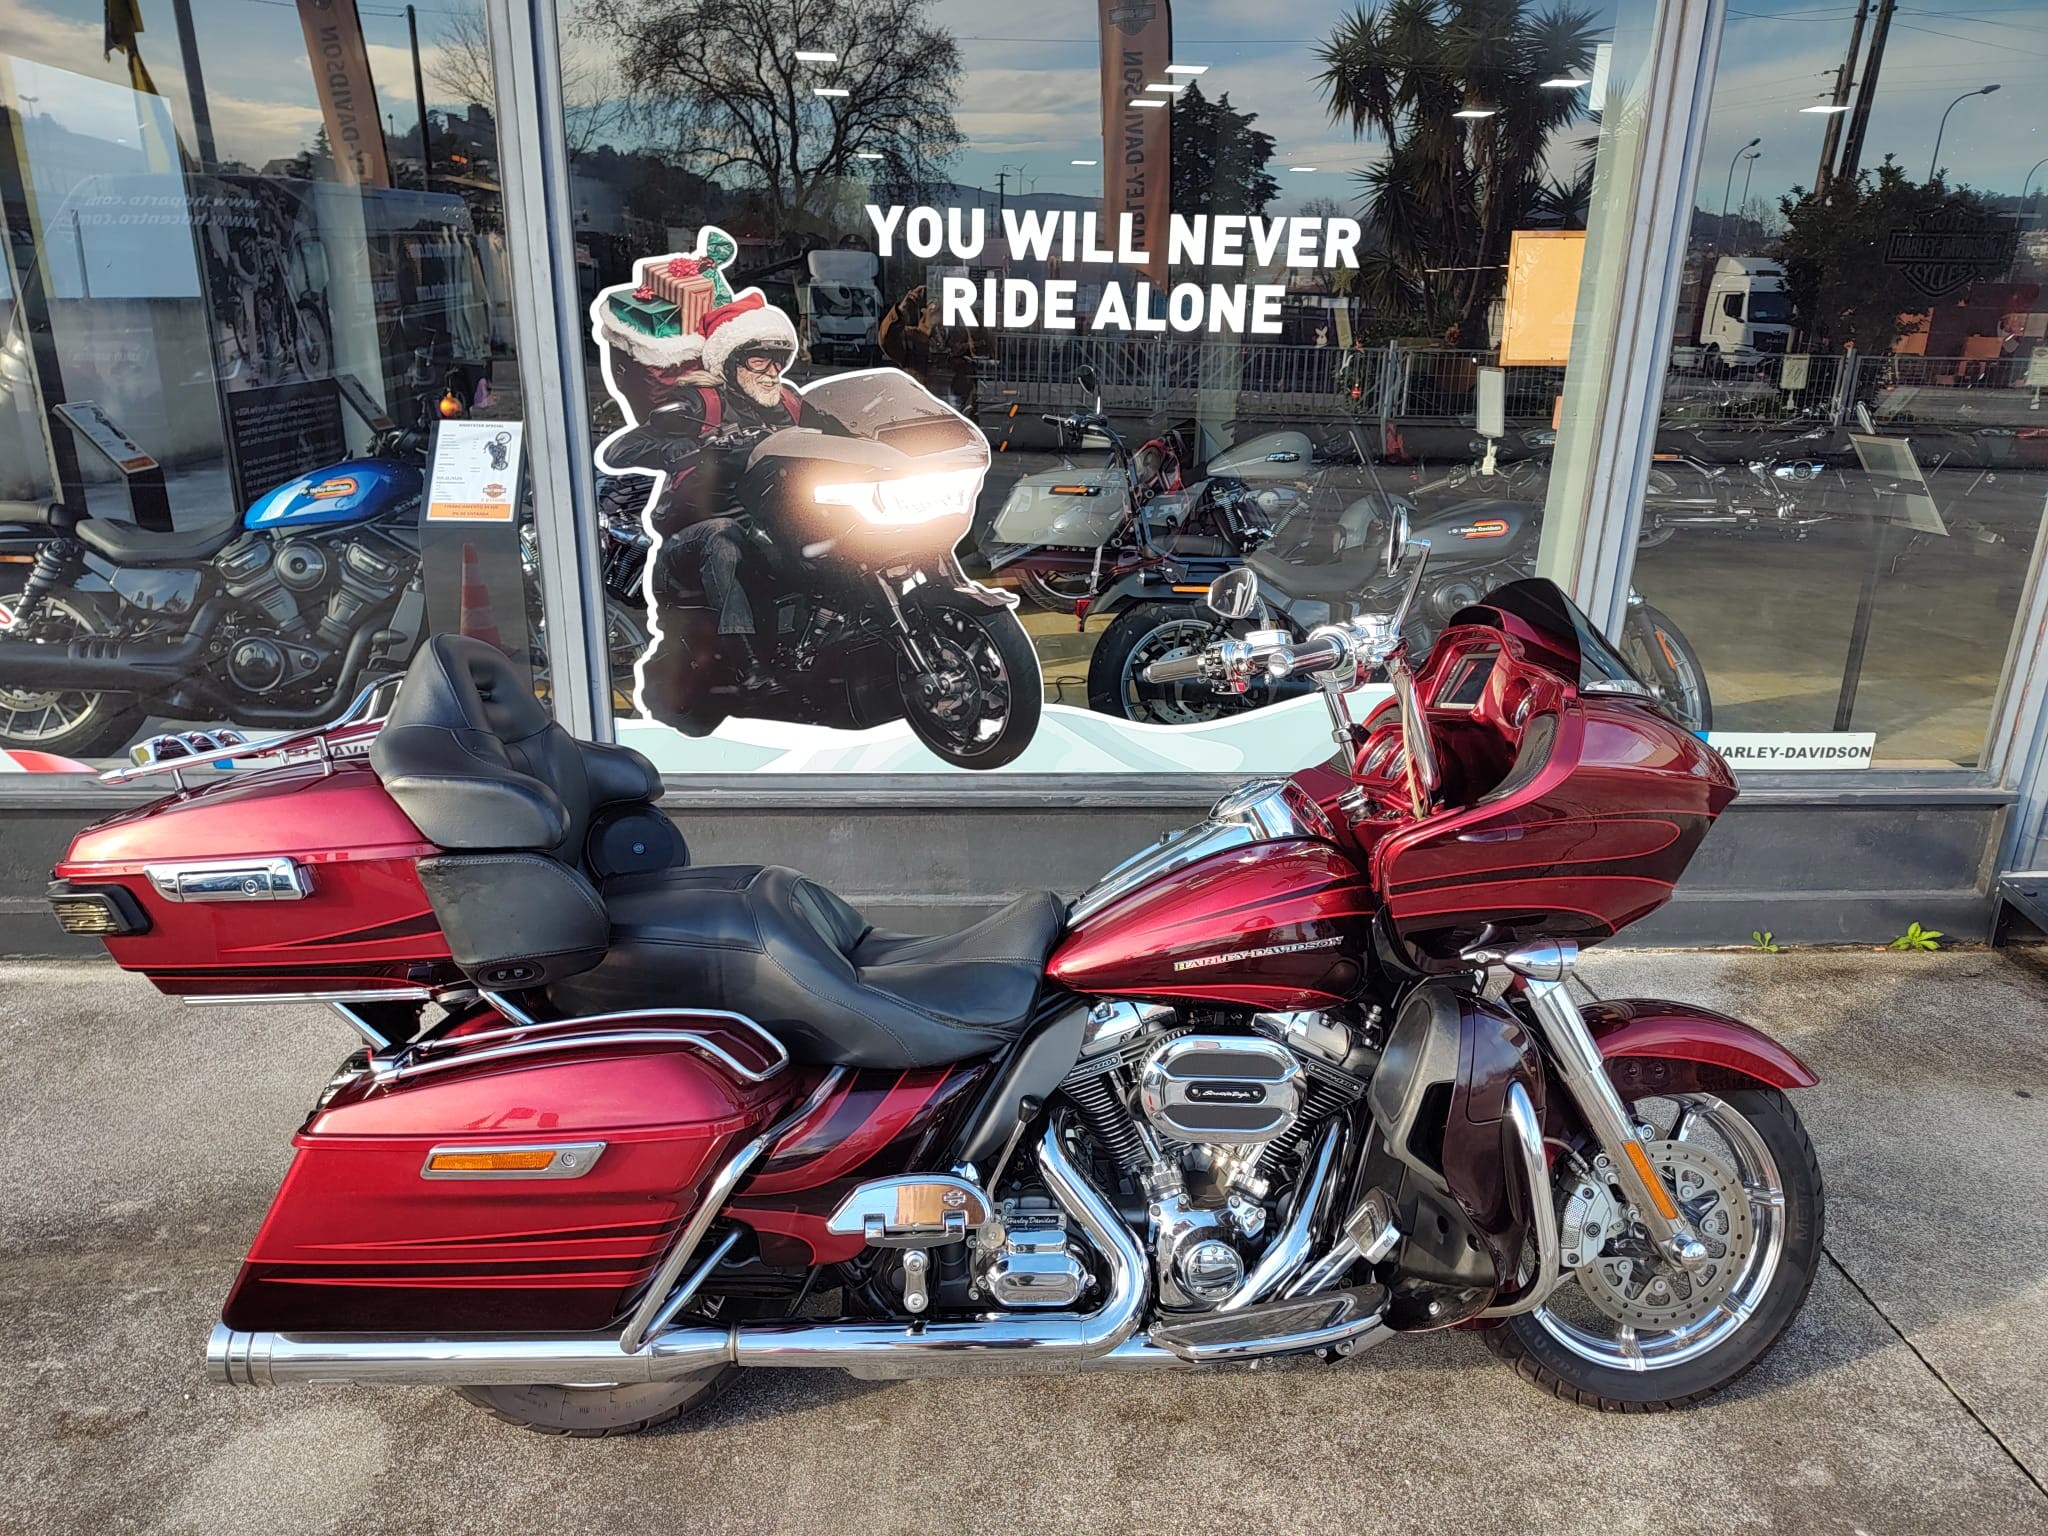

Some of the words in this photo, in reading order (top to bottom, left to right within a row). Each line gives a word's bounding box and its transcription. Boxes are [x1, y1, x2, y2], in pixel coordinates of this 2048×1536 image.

[865, 204, 985, 260] YOU
[1001, 209, 1150, 264] WILL
[1168, 214, 1361, 268] NEVER
[942, 277, 1077, 329] RIDE
[1091, 281, 1286, 334] ALONE
[1174, 935, 1345, 972] HARLEY-DAVIDSON
